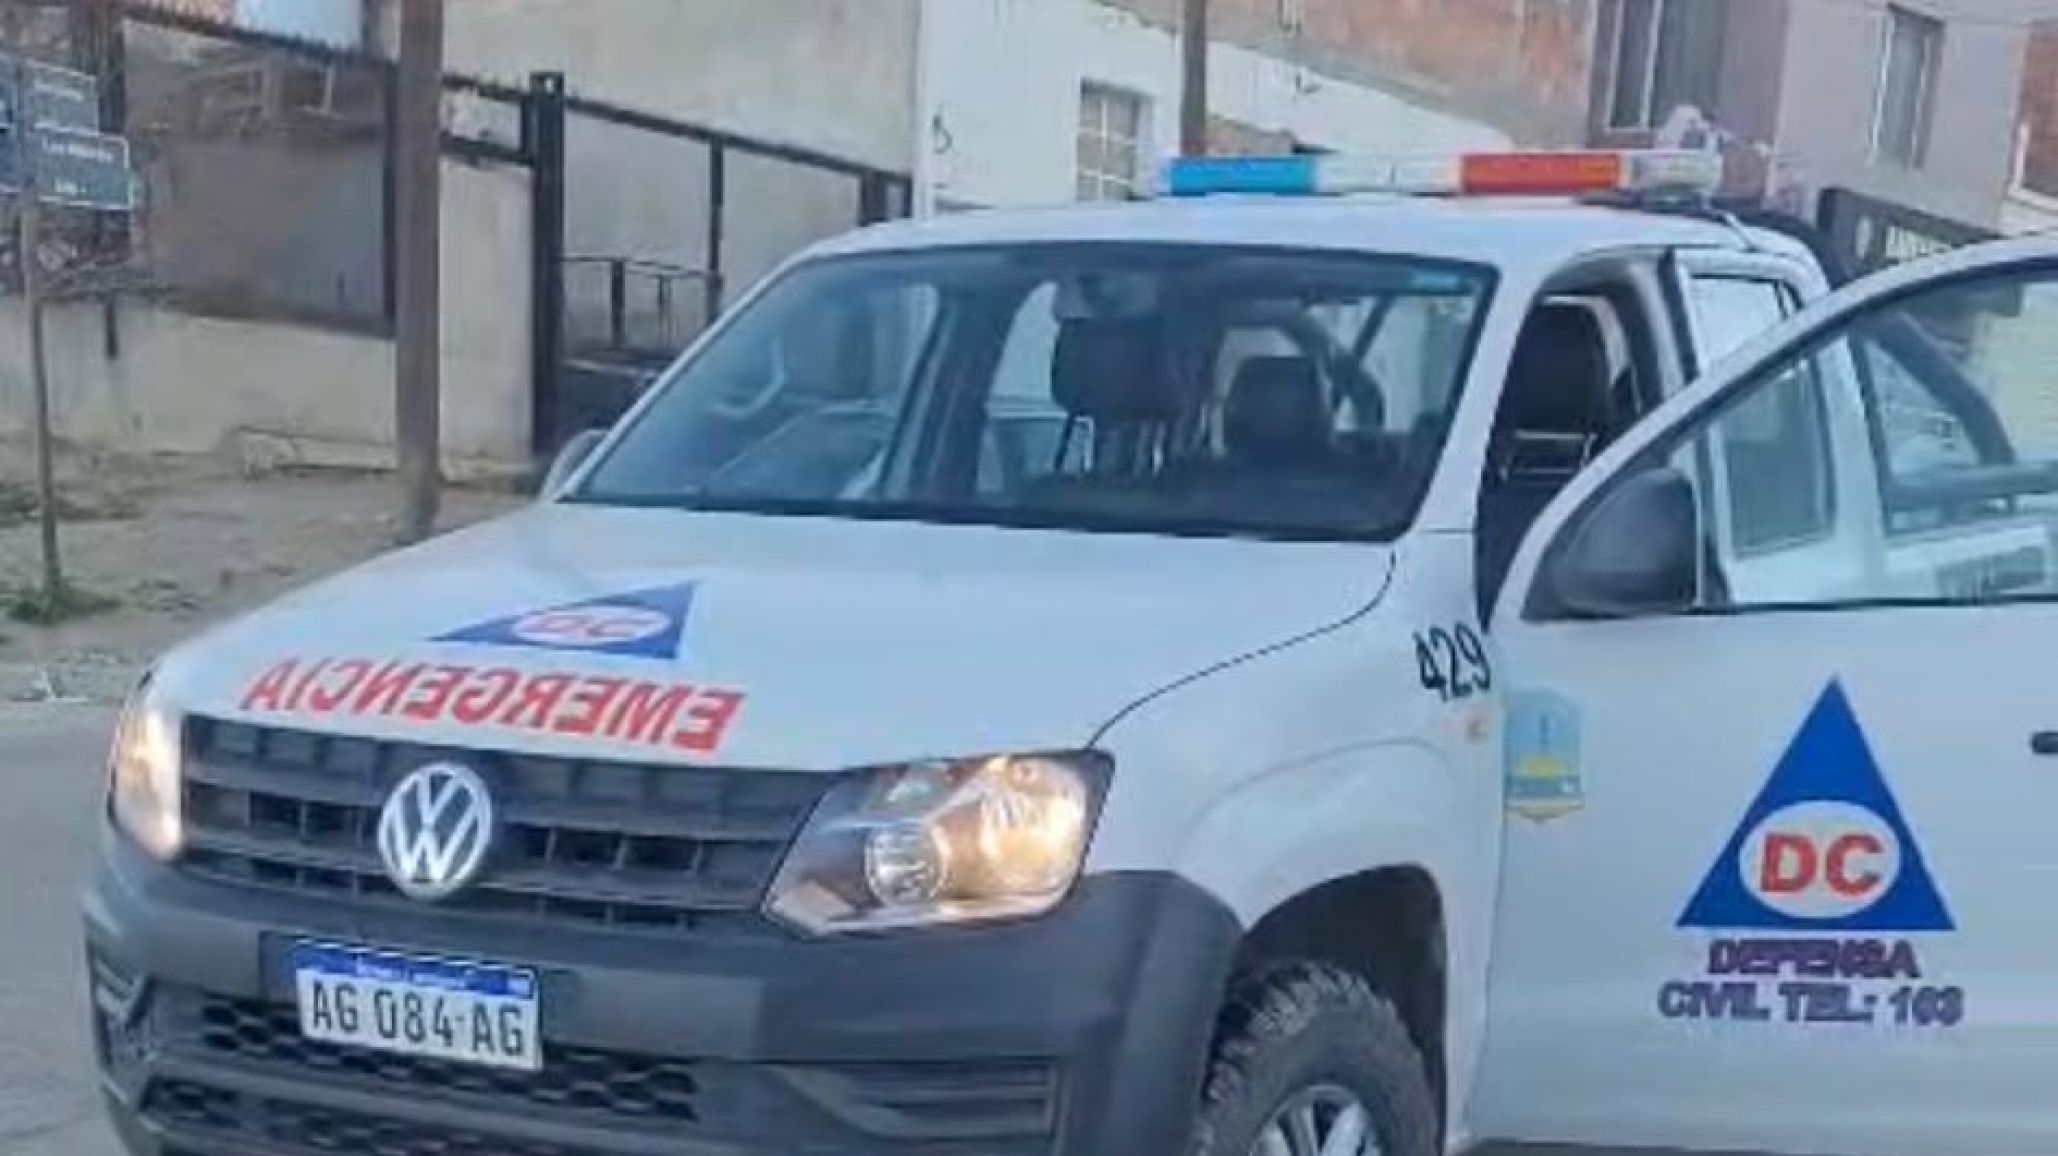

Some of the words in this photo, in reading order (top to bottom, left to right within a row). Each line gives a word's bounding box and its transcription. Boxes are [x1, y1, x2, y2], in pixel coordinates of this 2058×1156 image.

[1412, 619, 1492, 702] 429
[1759, 832, 1883, 898] DC
[1707, 938, 1922, 980] DEFENSA
[312, 980, 359, 1033] AG
[374, 988, 454, 1048] 084
[472, 1003, 524, 1058] AG
[1656, 978, 1771, 1022] CIVIL
